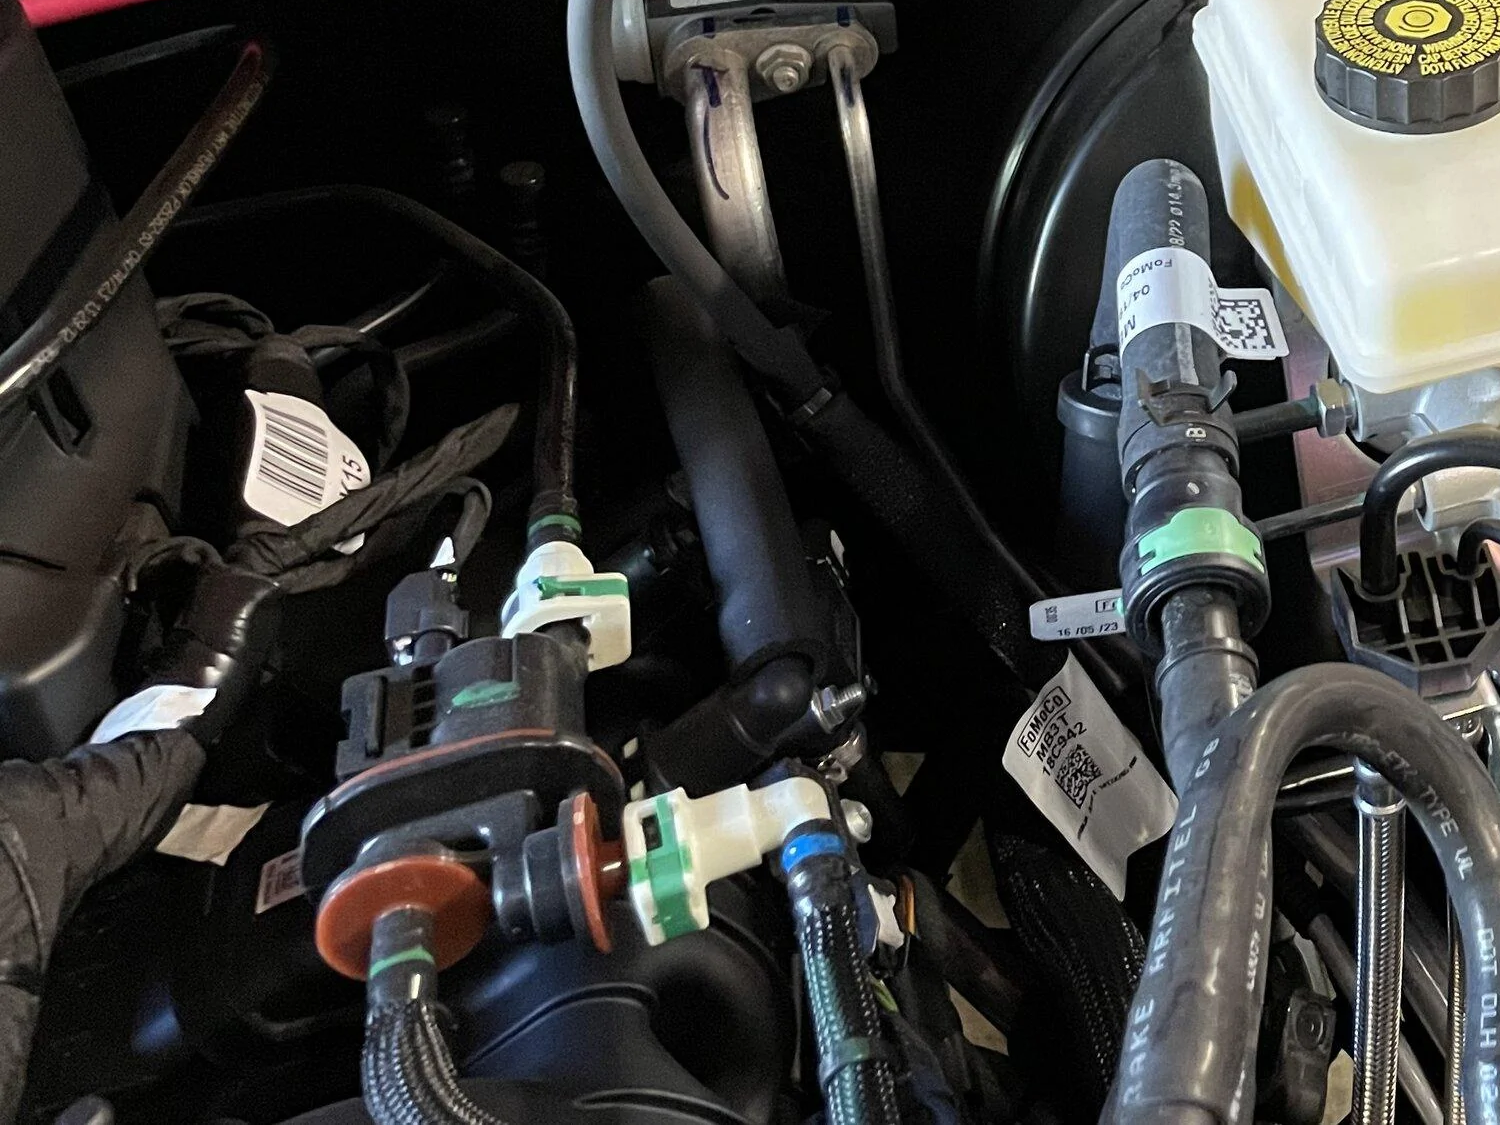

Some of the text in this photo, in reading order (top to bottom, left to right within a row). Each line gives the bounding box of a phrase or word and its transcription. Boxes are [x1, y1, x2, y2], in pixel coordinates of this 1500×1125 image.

[1418, 53, 1443, 64] CAP
[1420, 60, 1455, 75] DOT4
[1450, 50, 1486, 70] FLUID
[1020, 693, 1064, 752] FoMoCo
[1036, 712, 1069, 762] MB3T
[1042, 721, 1087, 776] 18C942
[1418, 784, 1459, 837] TYPE
